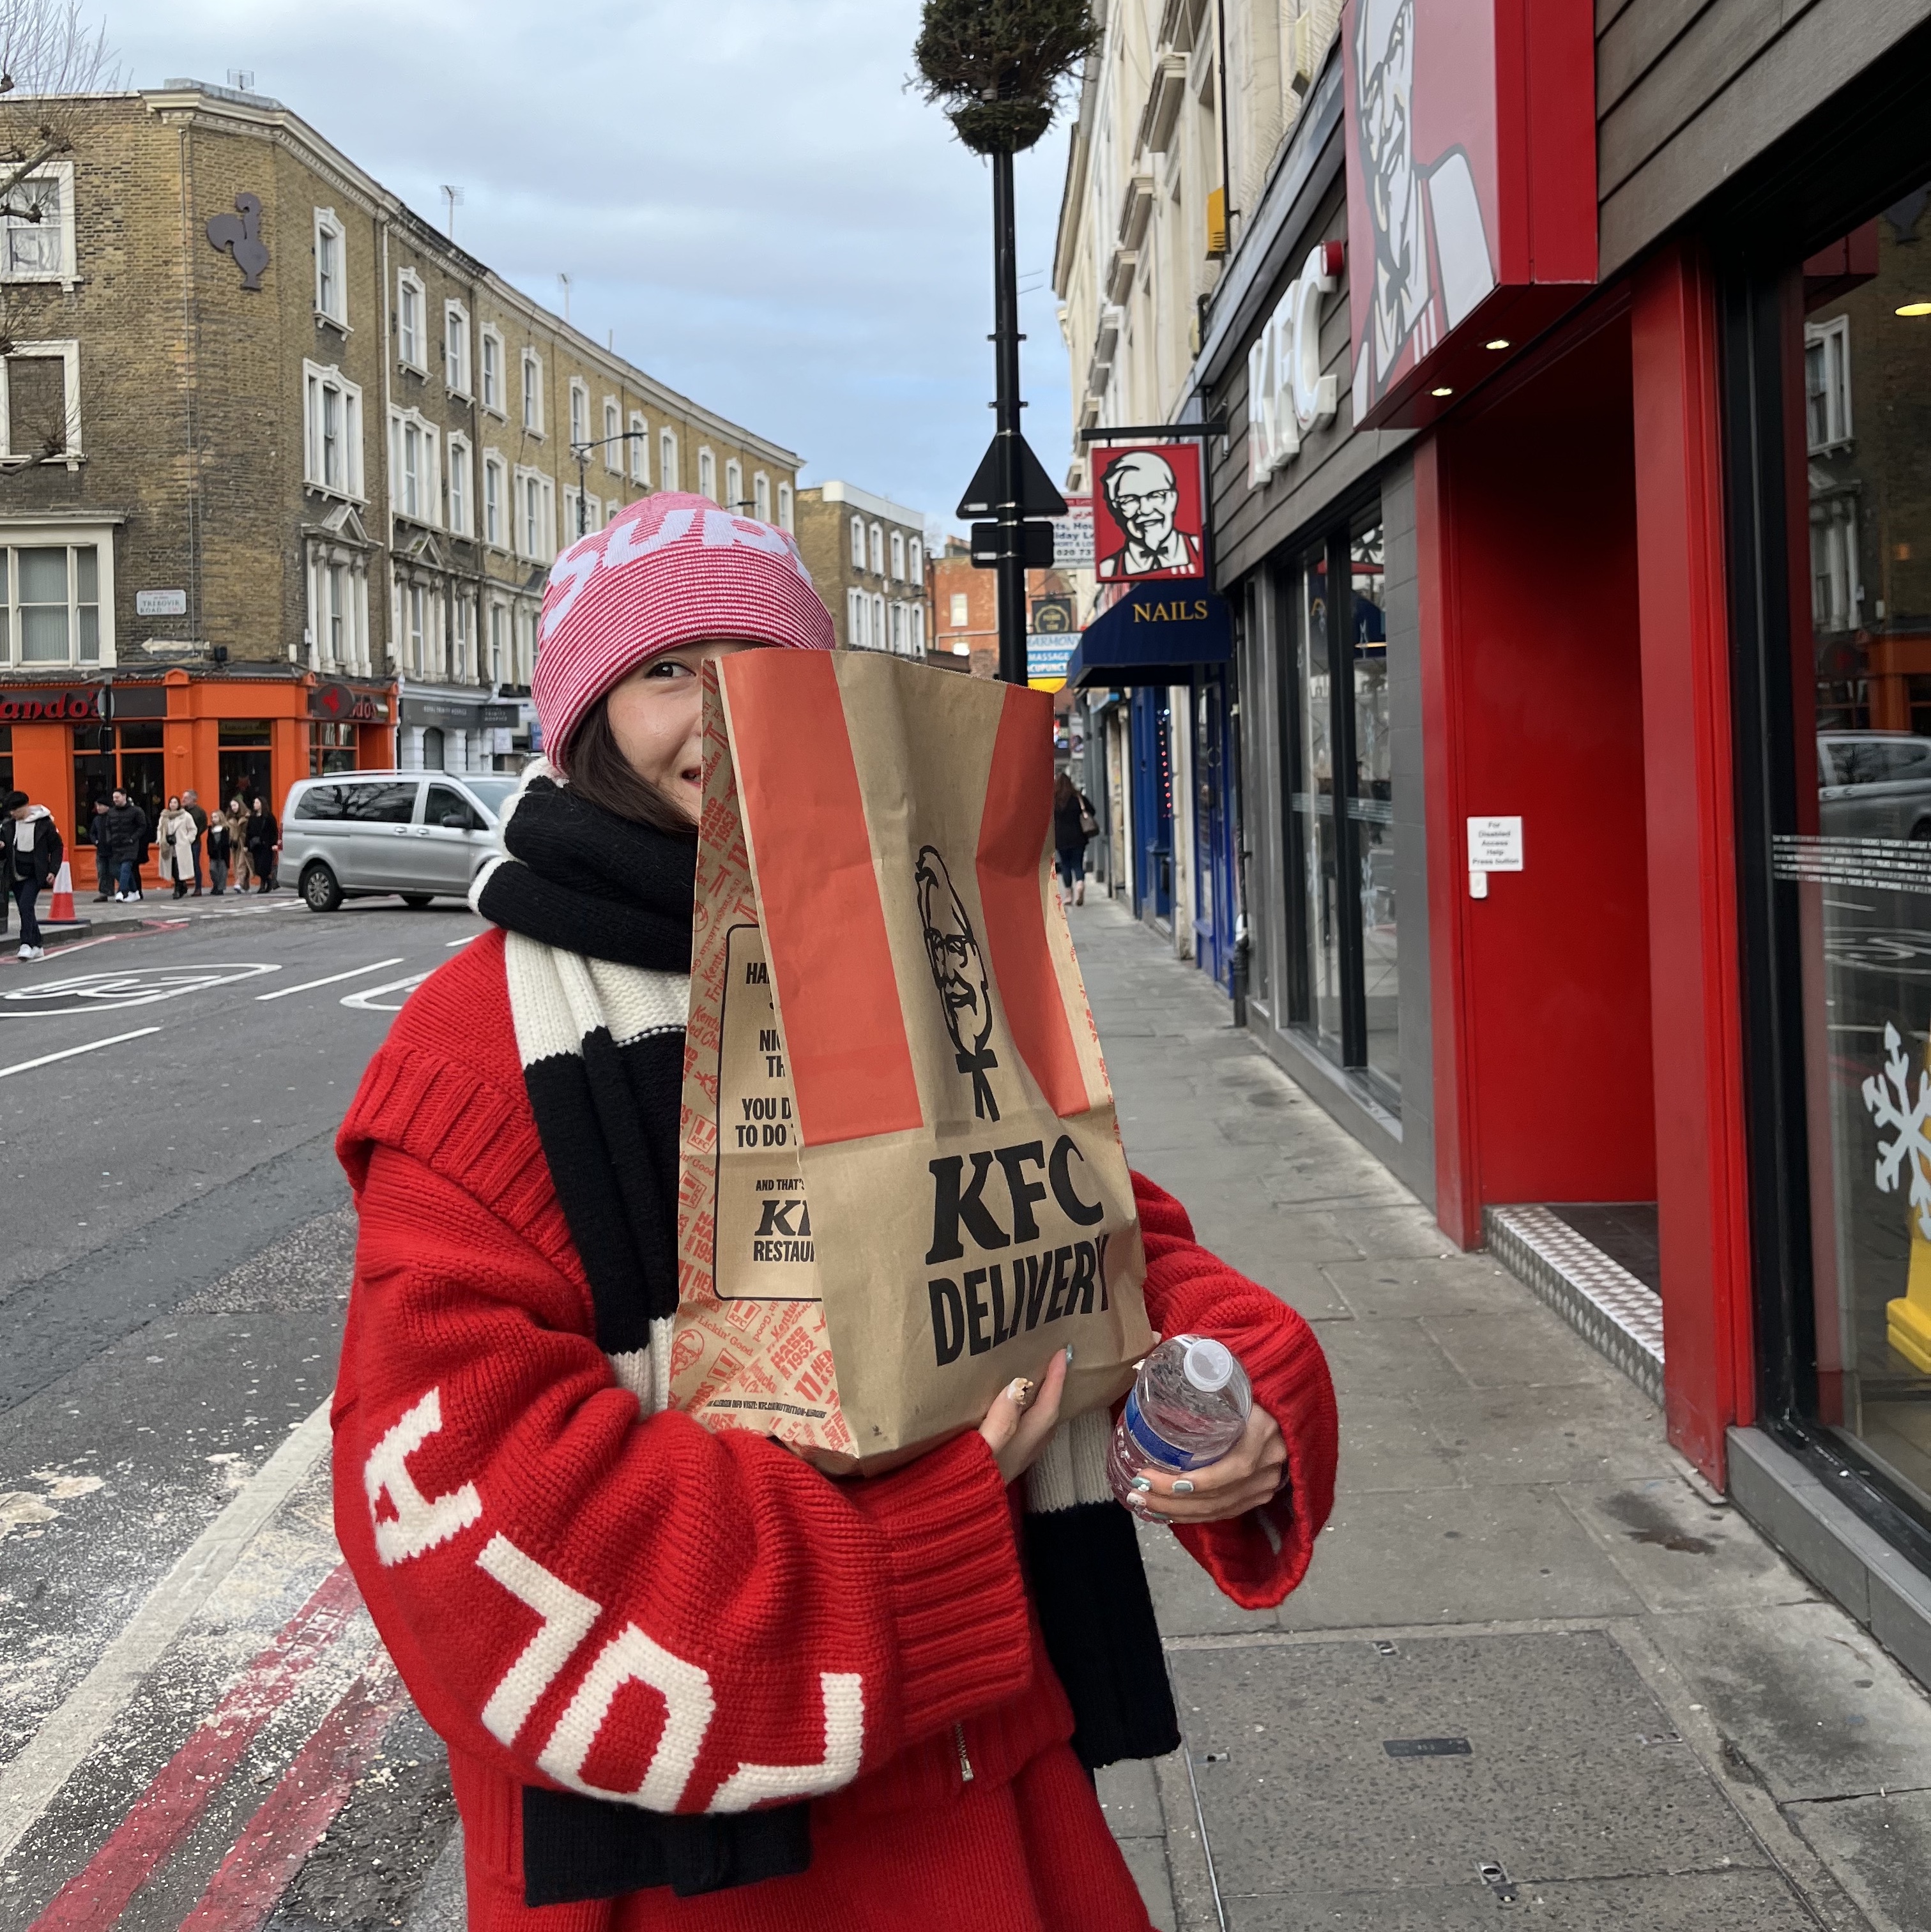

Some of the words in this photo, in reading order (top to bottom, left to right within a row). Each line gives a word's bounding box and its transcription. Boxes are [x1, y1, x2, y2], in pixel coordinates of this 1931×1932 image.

[1131, 599, 1209, 623] NAILS
[742, 1097, 777, 1121] YOU
[735, 1123, 758, 1148] TO
[763, 1123, 787, 1148] DO
[756, 1179, 774, 1191] AND
[926, 1134, 1105, 1266] KFC
[928, 1233, 1110, 1367] DELIVERY
